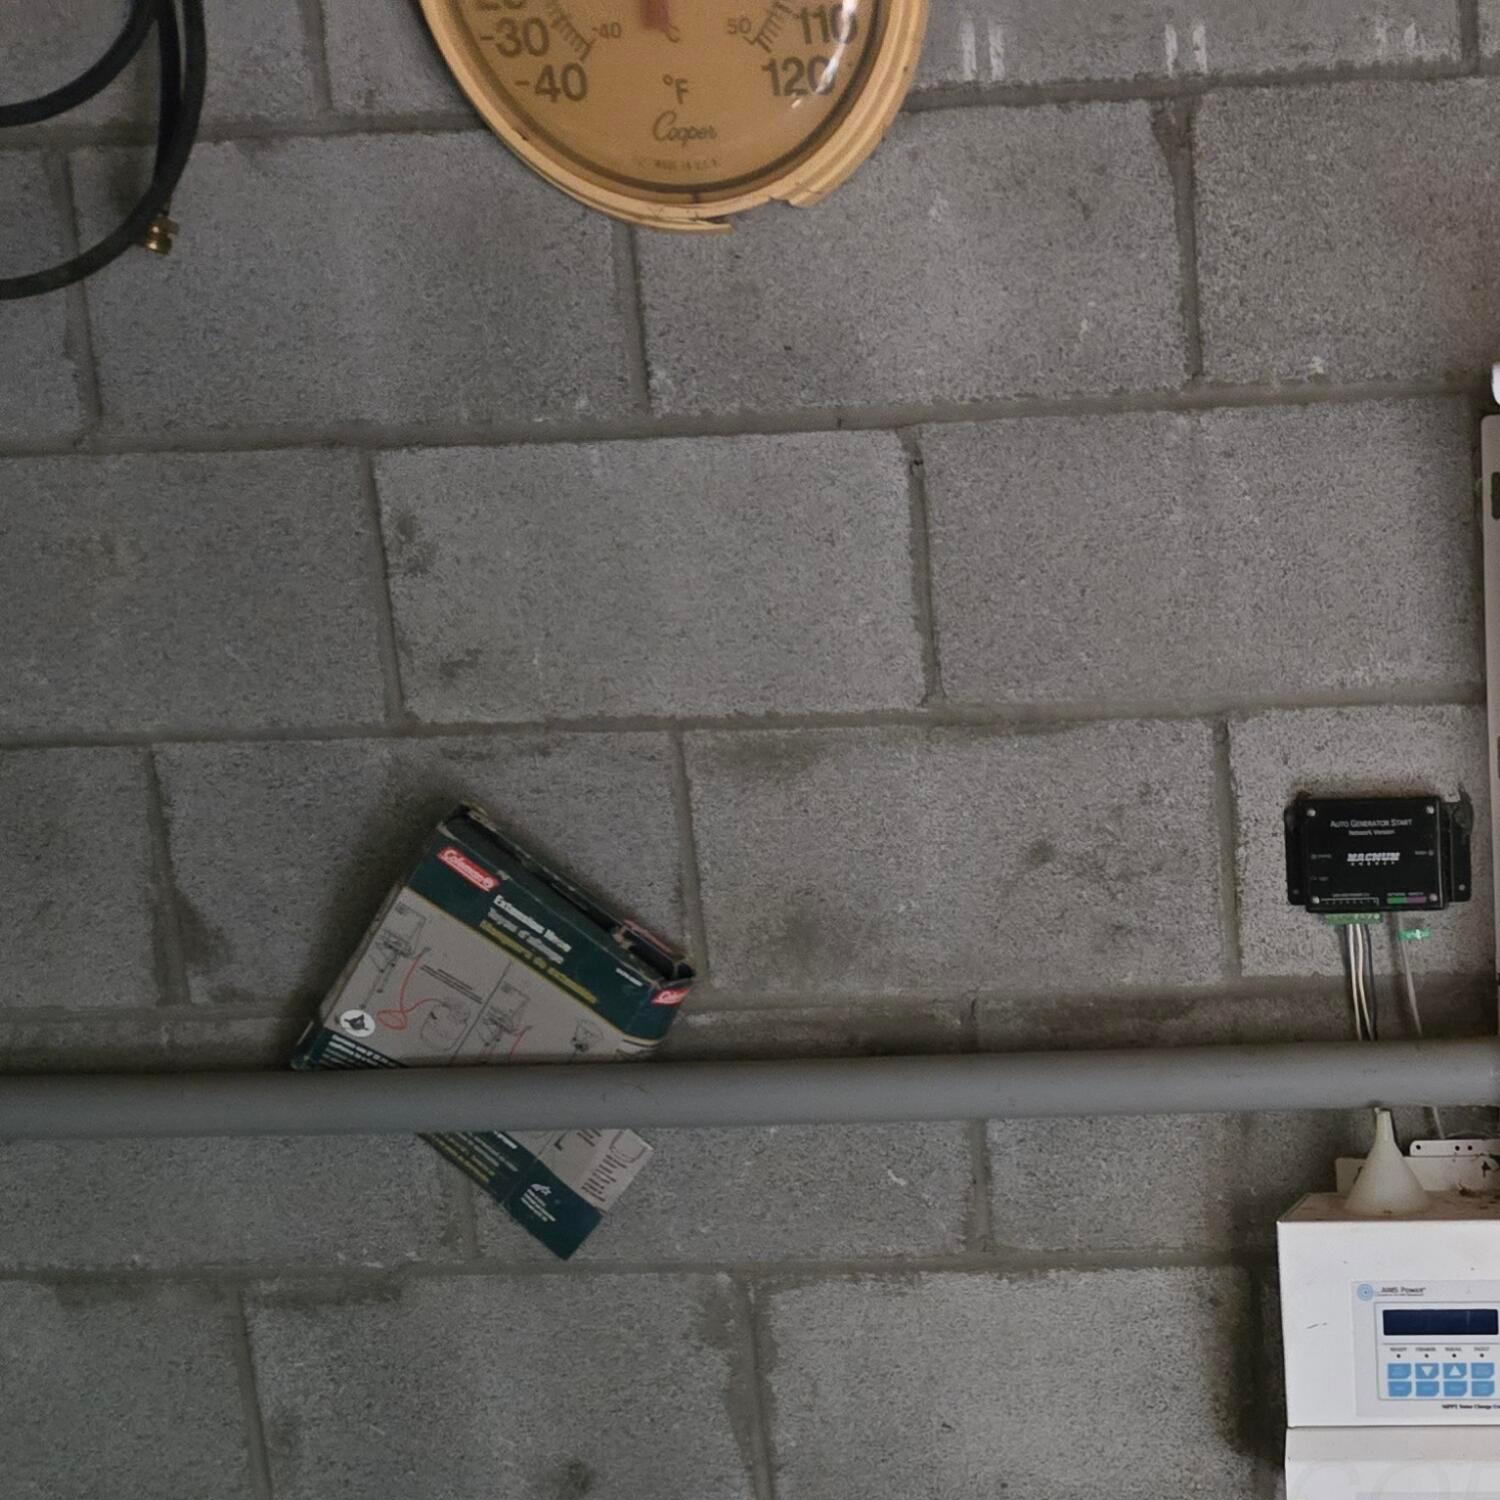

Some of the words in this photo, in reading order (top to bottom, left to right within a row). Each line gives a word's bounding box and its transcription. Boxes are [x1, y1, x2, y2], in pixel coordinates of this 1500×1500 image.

[480, 17, 549, 57] -30
[514, 63, 589, 101] -40
[762, 54, 836, 96] 120
[653, 110, 718, 147] Cooper
